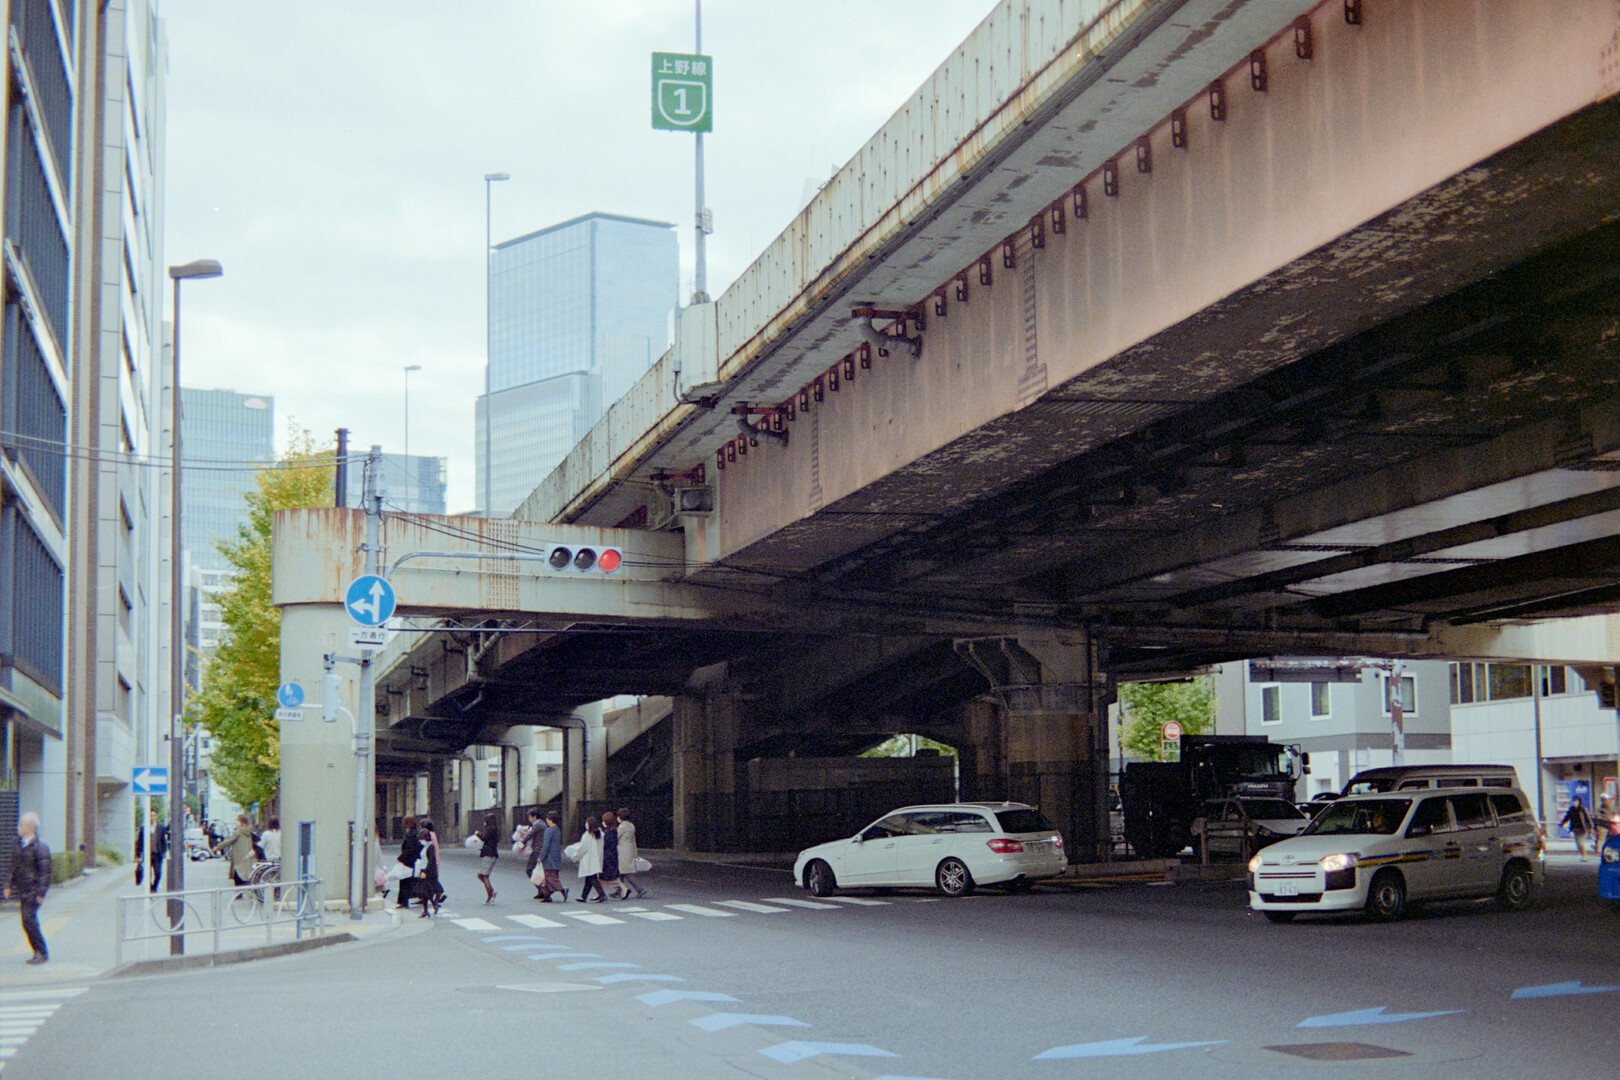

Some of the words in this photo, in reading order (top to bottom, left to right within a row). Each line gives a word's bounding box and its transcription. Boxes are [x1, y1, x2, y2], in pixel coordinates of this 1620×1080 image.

[658, 58, 706, 76] 上野線
[673, 88, 691, 115] 1
[352, 631, 385, 640] 一方通行
